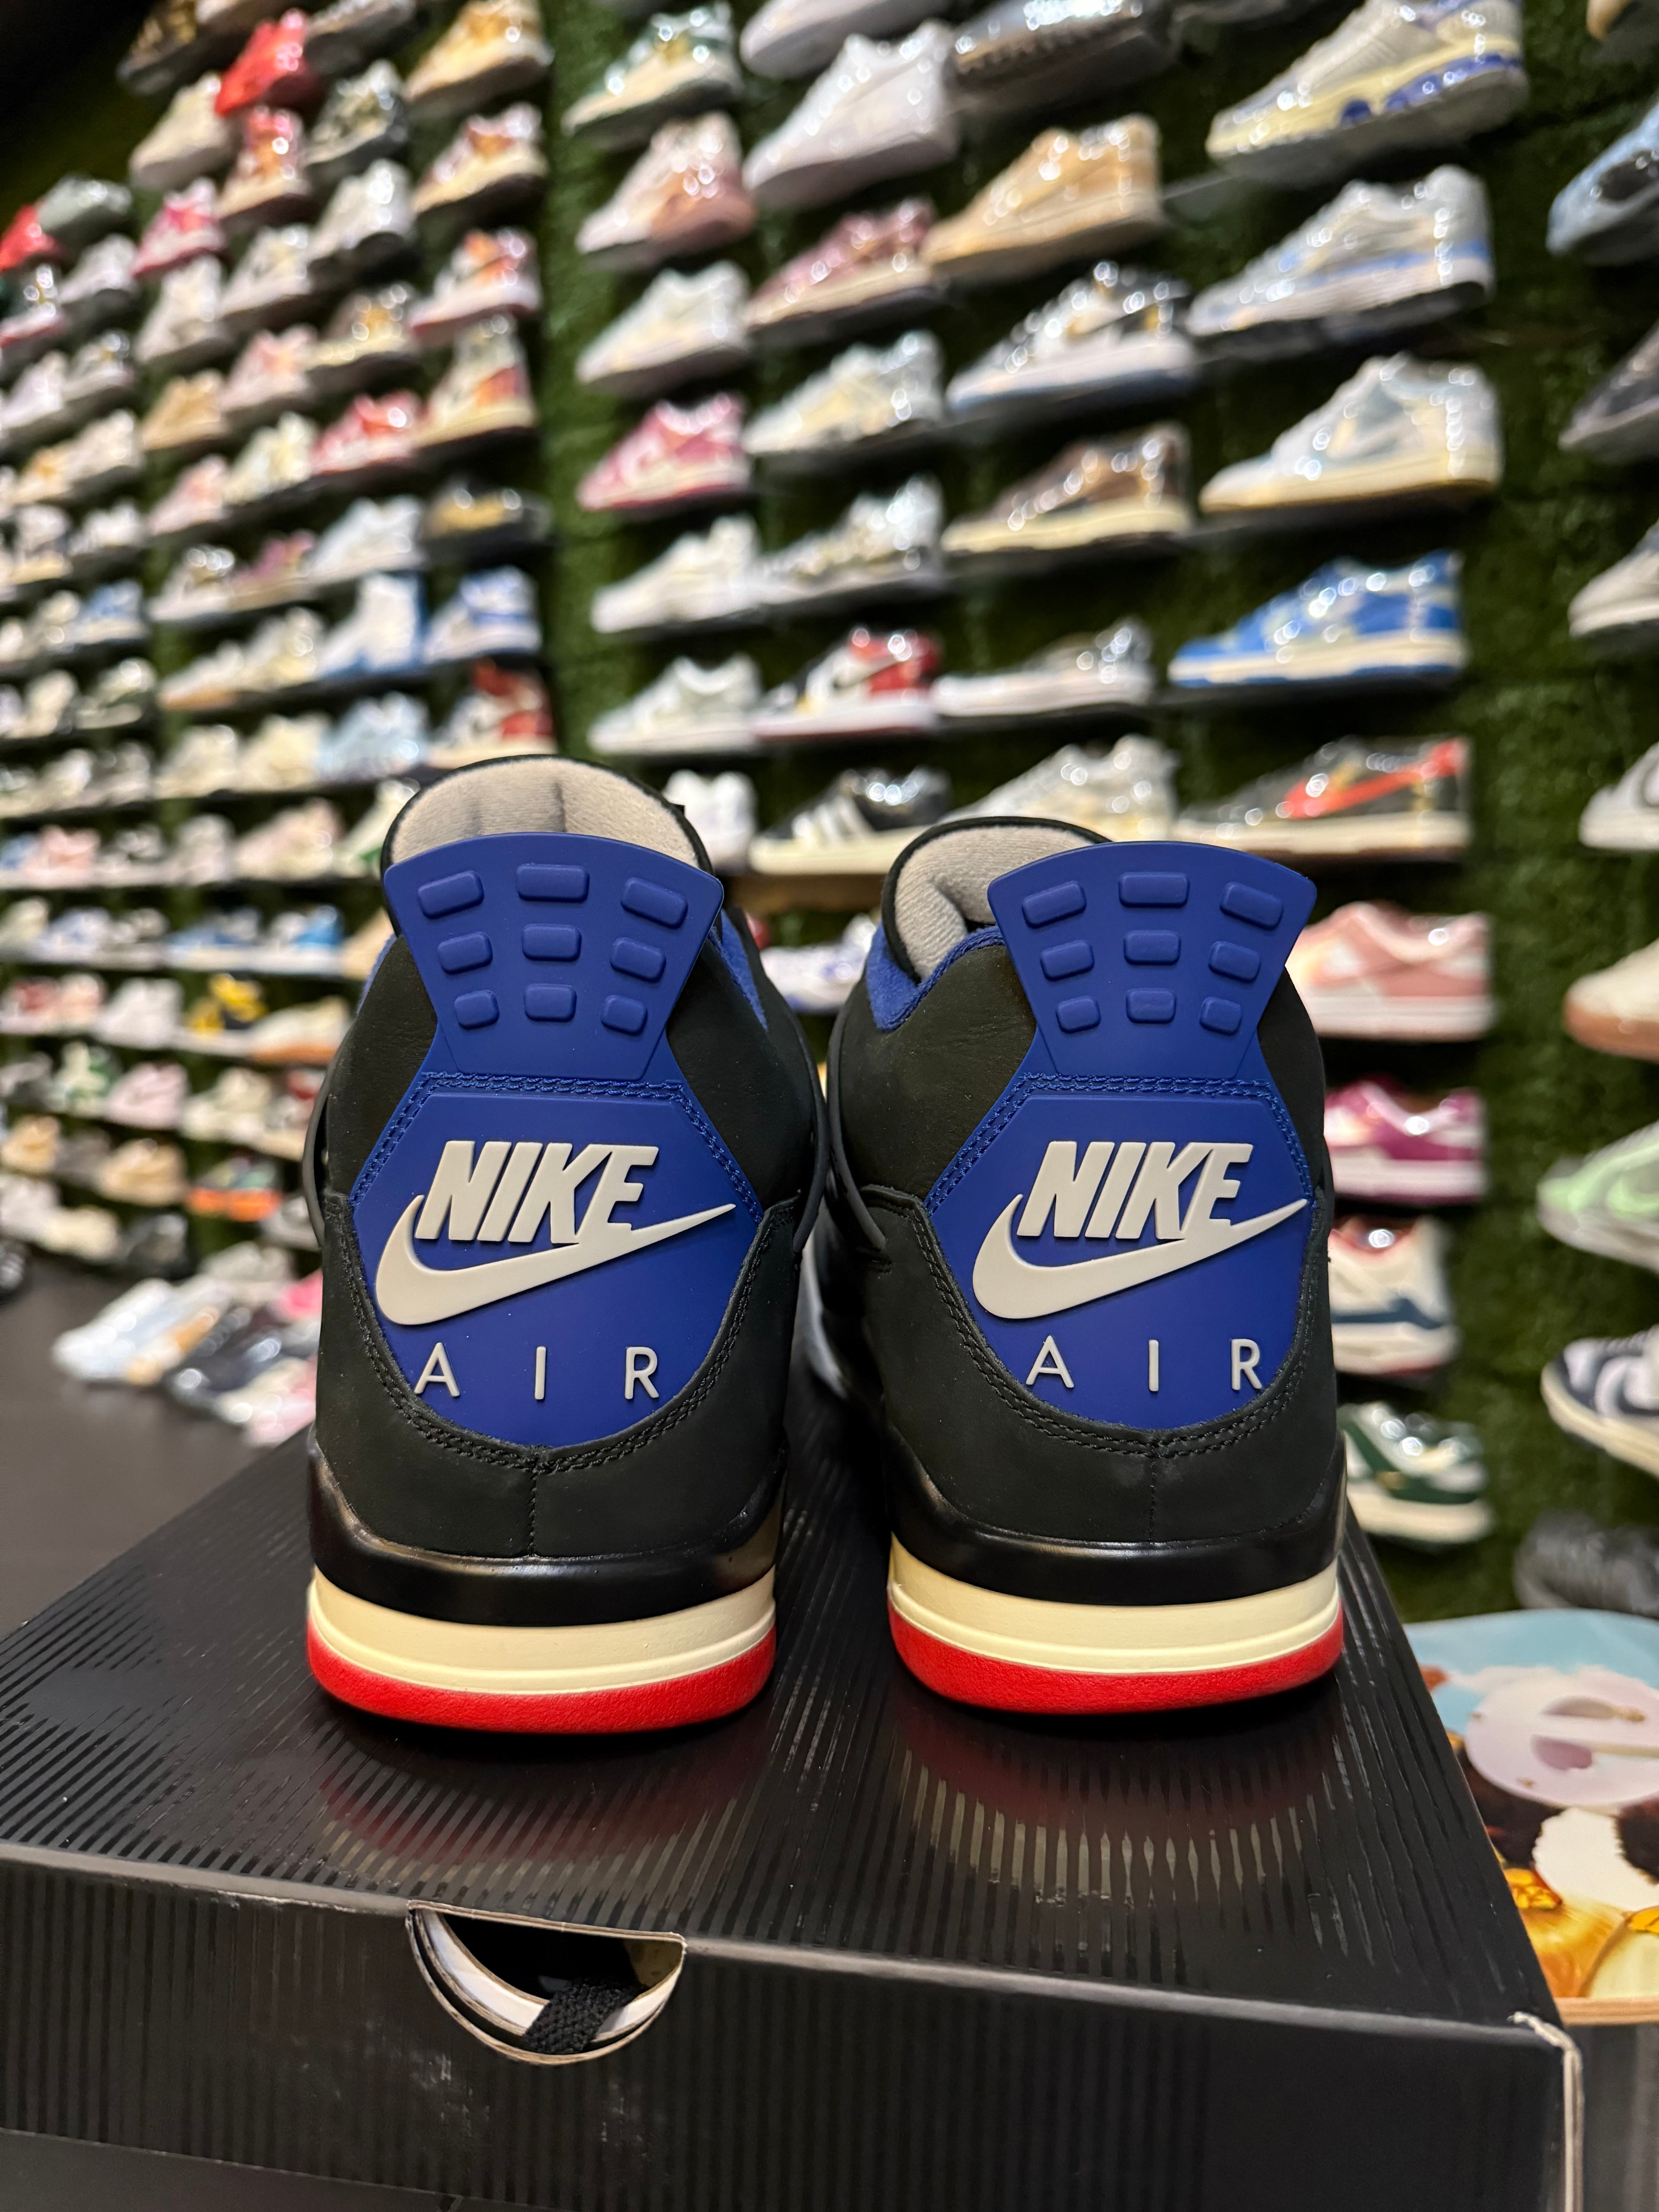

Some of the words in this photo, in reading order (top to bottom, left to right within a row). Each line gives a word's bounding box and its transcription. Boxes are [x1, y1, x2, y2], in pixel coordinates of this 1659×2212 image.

[414, 1140, 659, 1244] NIKE
[1016, 1141, 1254, 1240] NIKE
[413, 1342, 660, 1400] AIR
[1025, 1335, 1263, 1392] AIR
